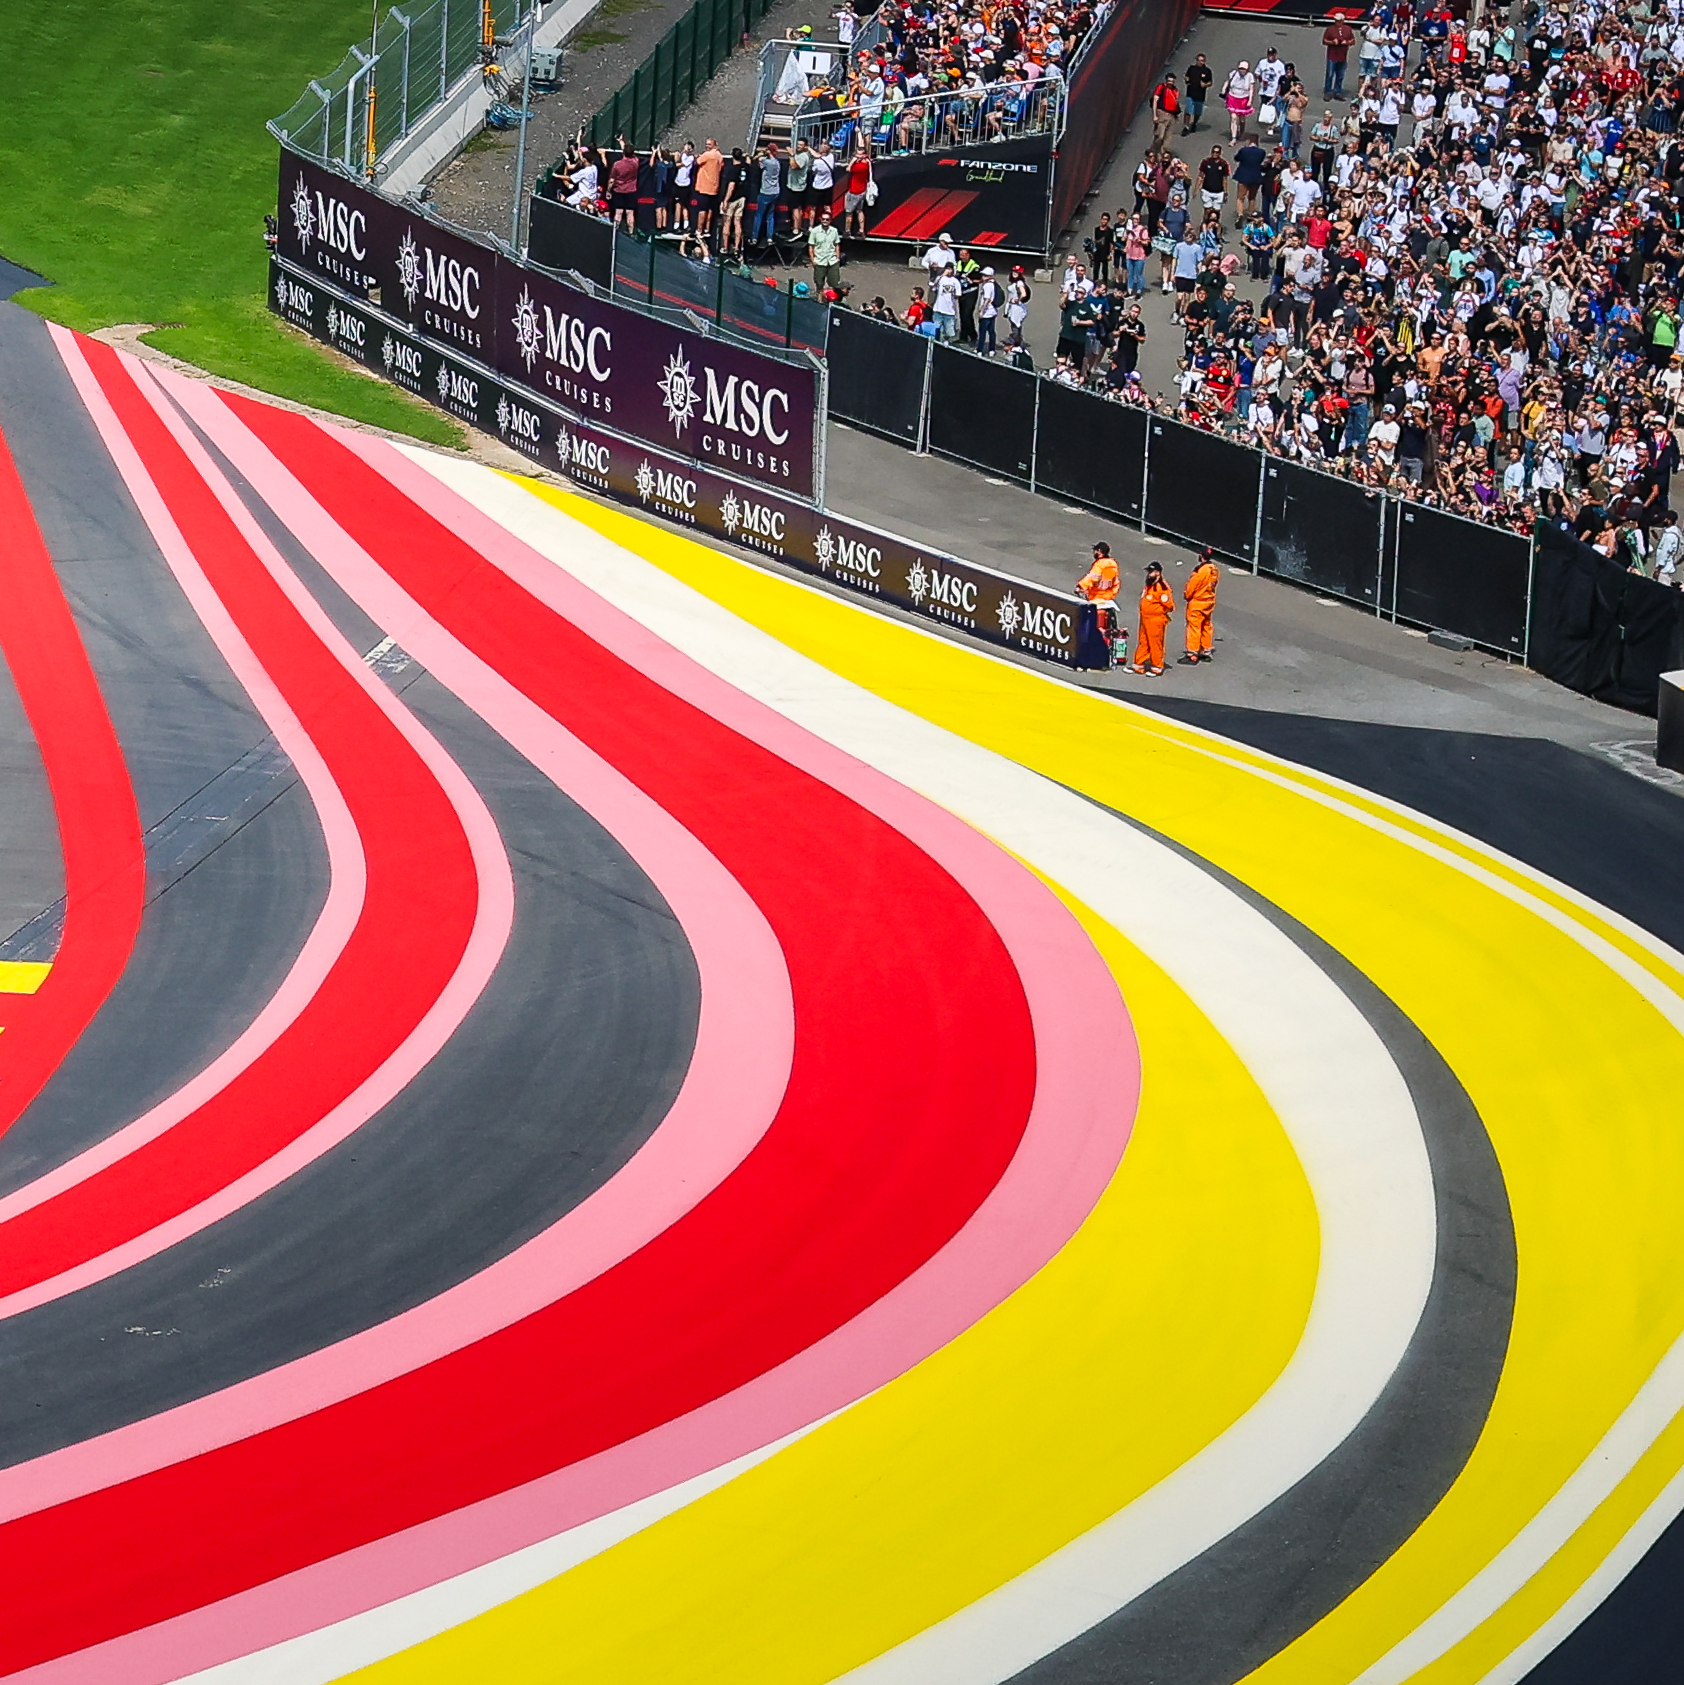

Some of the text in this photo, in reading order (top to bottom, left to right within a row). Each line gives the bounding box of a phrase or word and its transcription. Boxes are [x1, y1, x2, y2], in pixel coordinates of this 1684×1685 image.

[960, 159, 1038, 173] FANZONE
[315, 191, 366, 261] MSC
[317, 251, 369, 290] CRUISES
[424, 247, 480, 319] MSC
[288, 281, 313, 316] MSC
[339, 310, 365, 346] MSC
[425, 310, 481, 348] CRUISES
[543, 304, 611, 382] MSC
[395, 342, 421, 377] MSC
[450, 371, 478, 408] MSC
[545, 370, 612, 413] CRUISES
[703, 367, 789, 445] MSC
[511, 403, 540, 442] MSC
[510, 435, 540, 456] CRUISES
[572, 433, 609, 475] MSC
[702, 436, 789, 476] CRUISES
[571, 467, 609, 489] CRUISES
[656, 469, 697, 508] MSC
[655, 501, 696, 524] CRUISES
[742, 500, 785, 541] MSC
[741, 533, 784, 556] CRUISES
[837, 535, 881, 578] MSC
[836, 569, 880, 593] CRUISES
[930, 568, 977, 613] MSC
[929, 604, 975, 629] CRUISES
[1021, 601, 1070, 644] MSC
[1020, 637, 1069, 660] CRUISES
